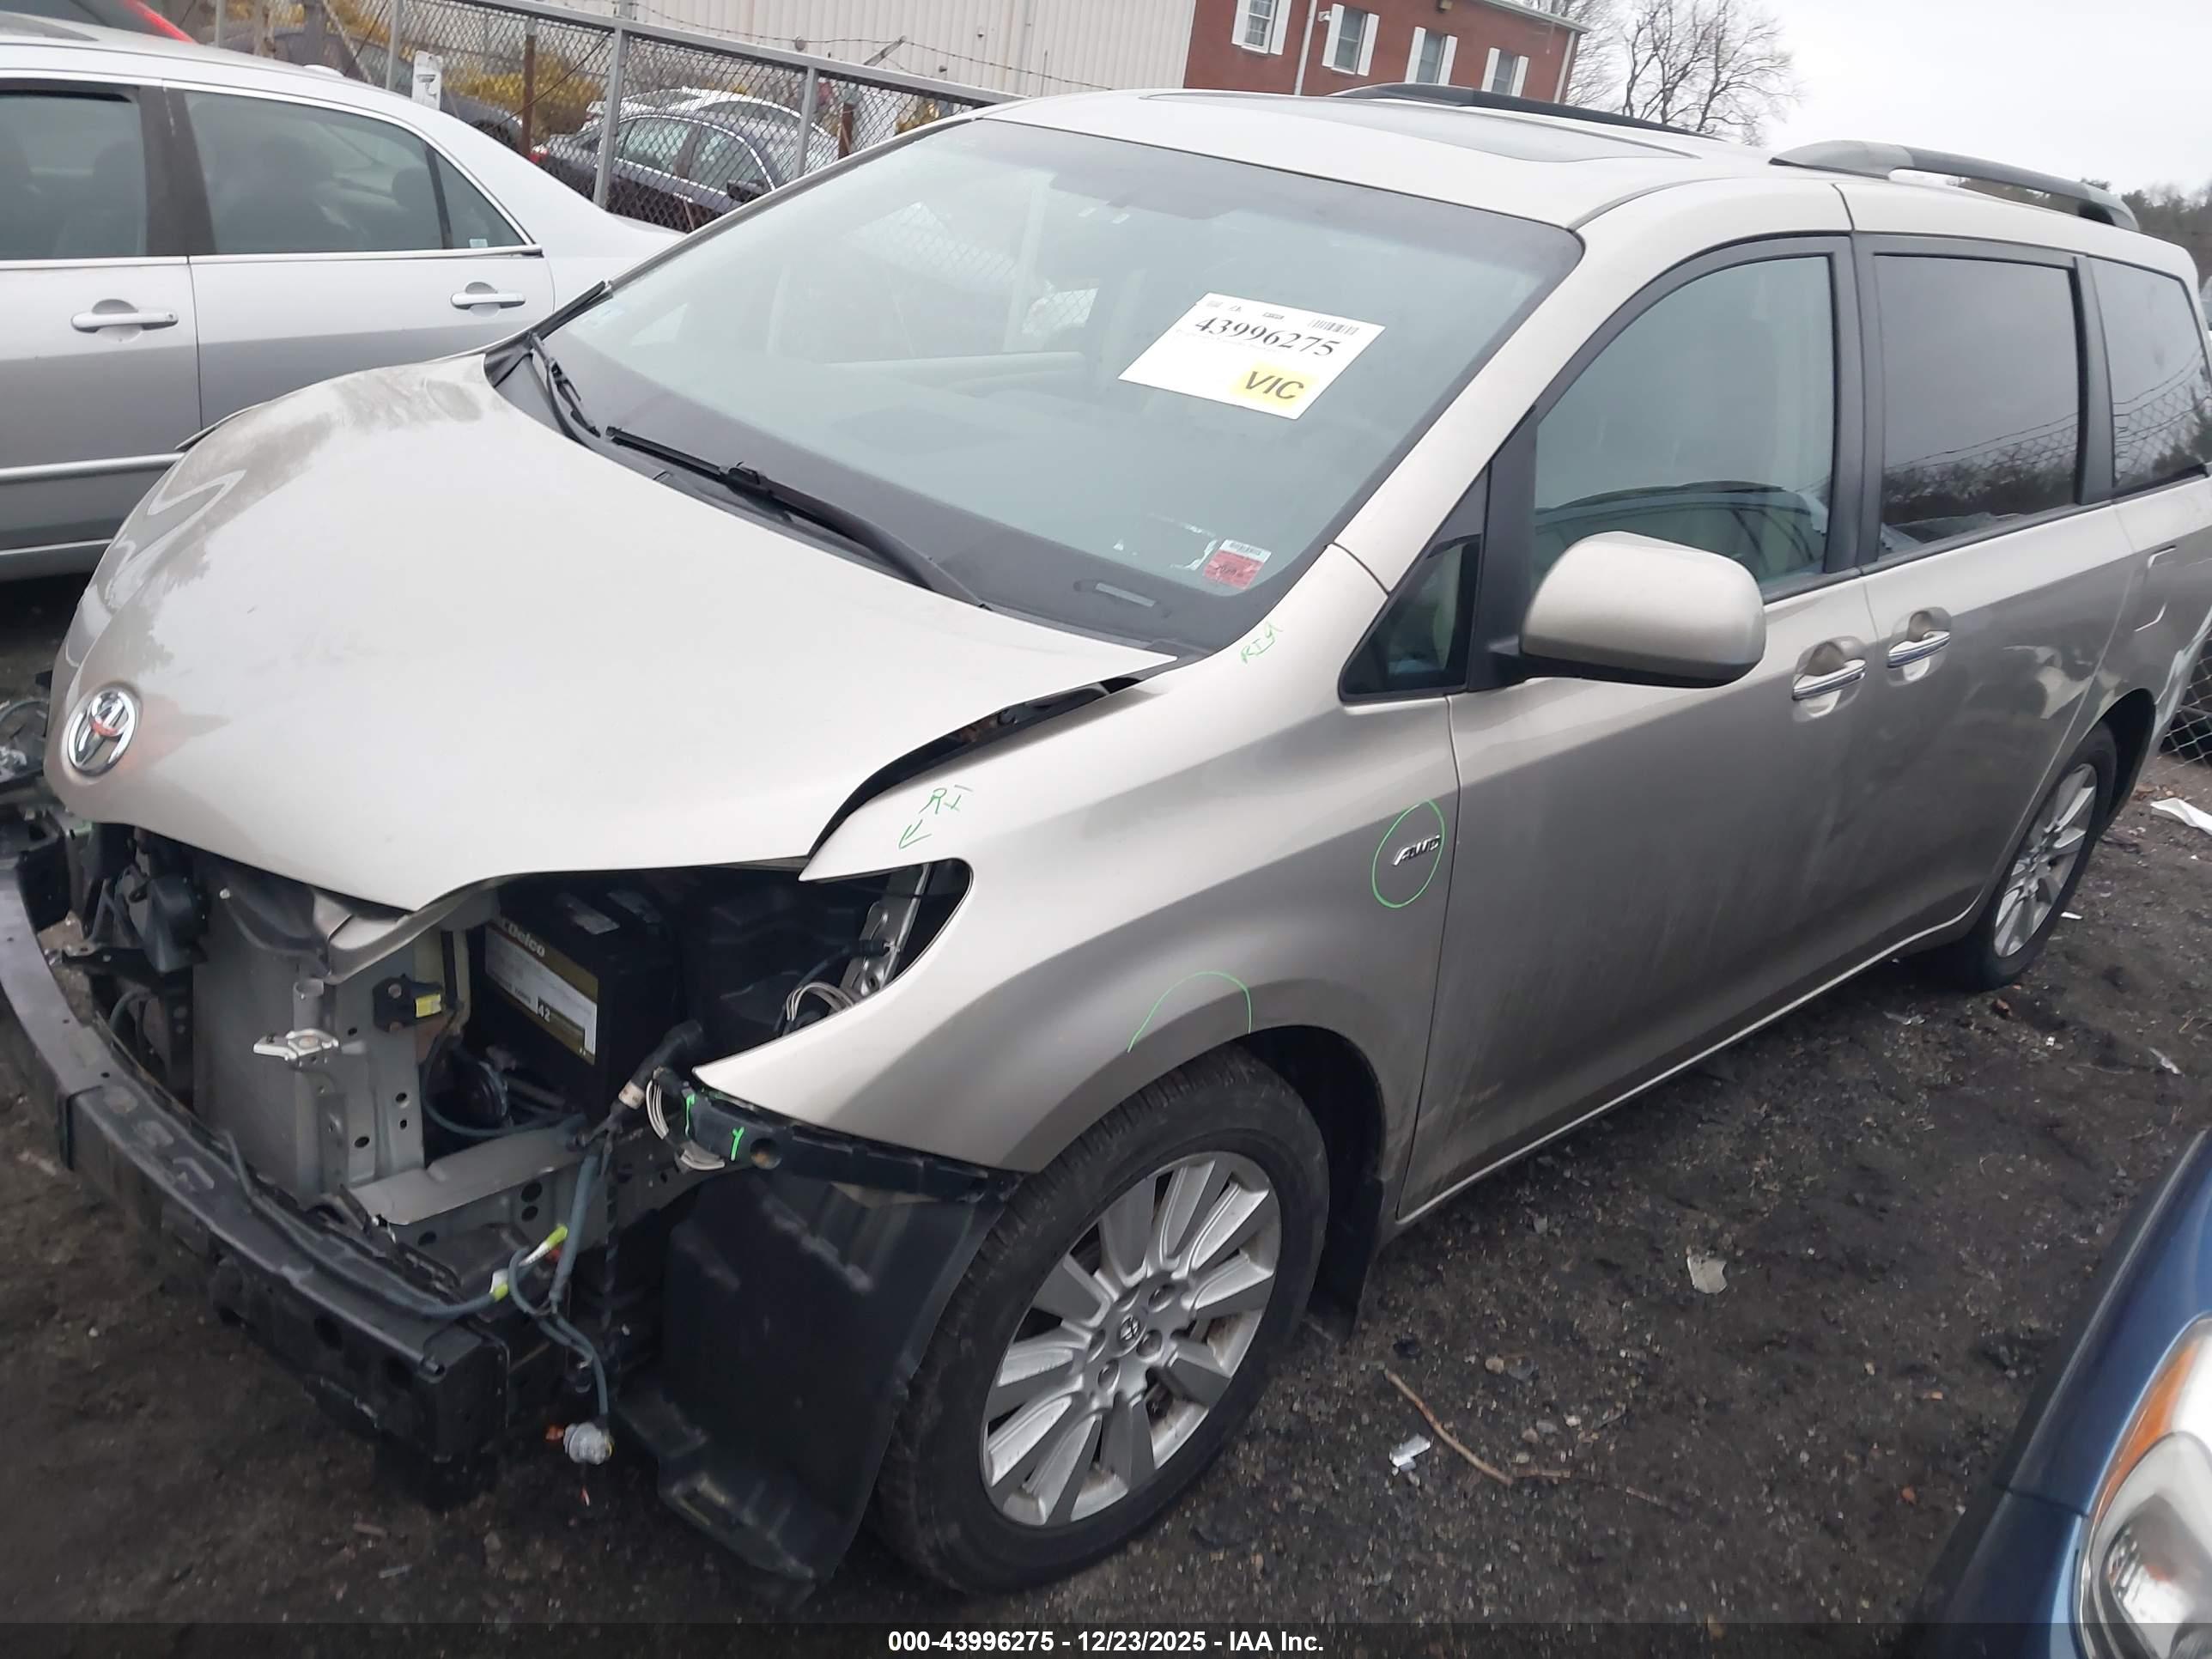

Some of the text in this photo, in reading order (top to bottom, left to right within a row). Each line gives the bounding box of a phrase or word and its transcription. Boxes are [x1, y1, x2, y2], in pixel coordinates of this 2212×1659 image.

[1194, 315, 1340, 357] 43996275
[1244, 370, 1304, 400] VIC
[1392, 833, 1441, 866] AWD
